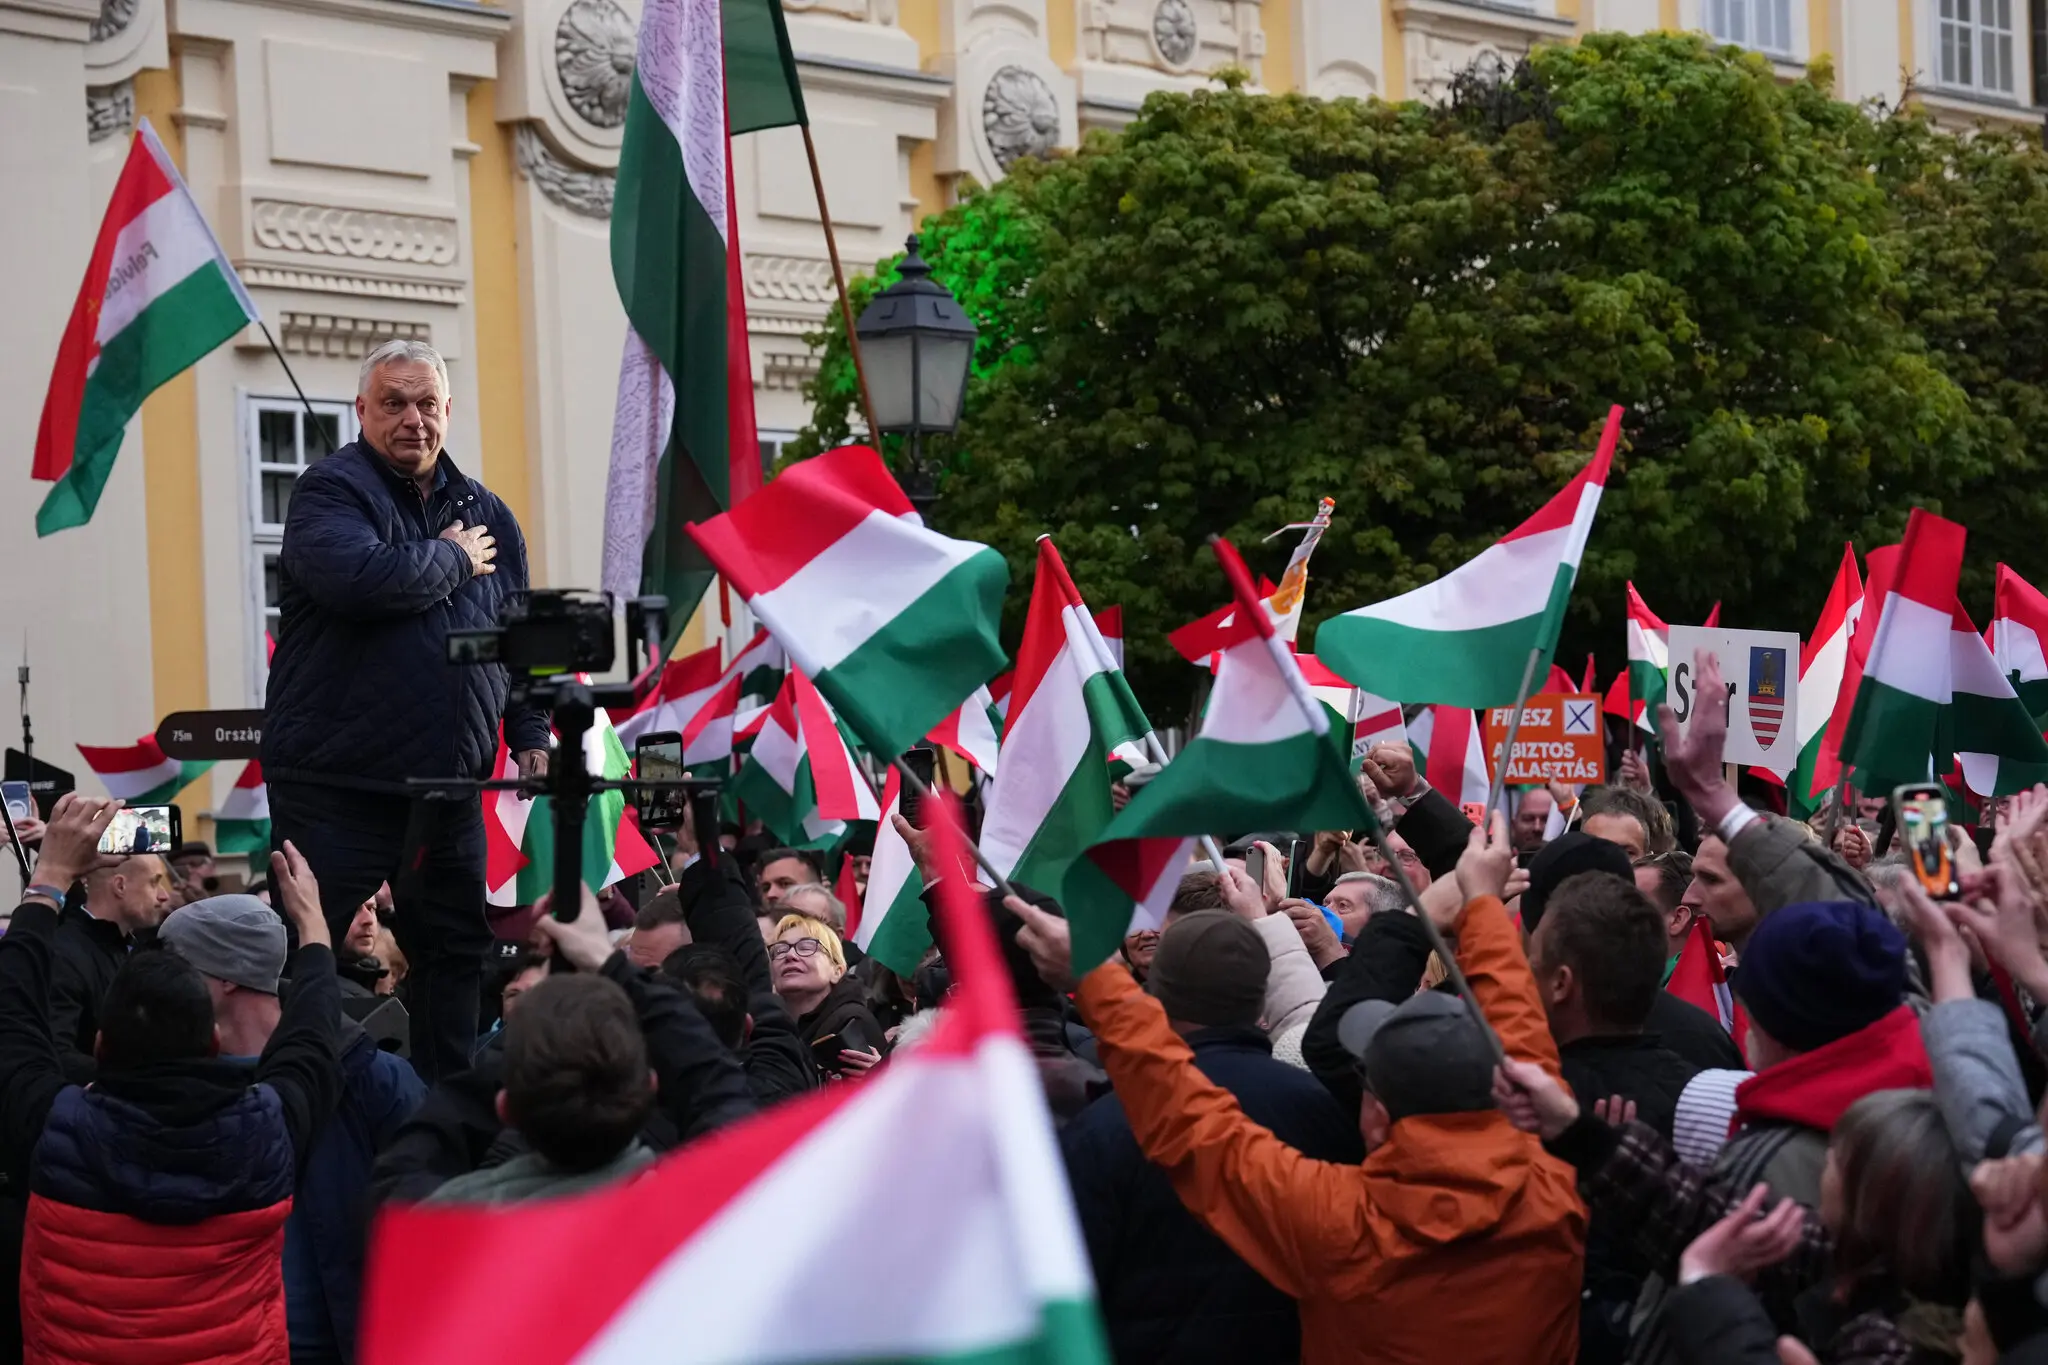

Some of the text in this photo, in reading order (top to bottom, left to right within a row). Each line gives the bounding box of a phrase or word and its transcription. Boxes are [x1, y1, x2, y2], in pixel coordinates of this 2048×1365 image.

[1673, 662, 1737, 729] Sr
[1491, 708, 1553, 727] FIESZ
[173, 729, 193, 742] 75m
[1510, 742, 1576, 759] BIZTOS
